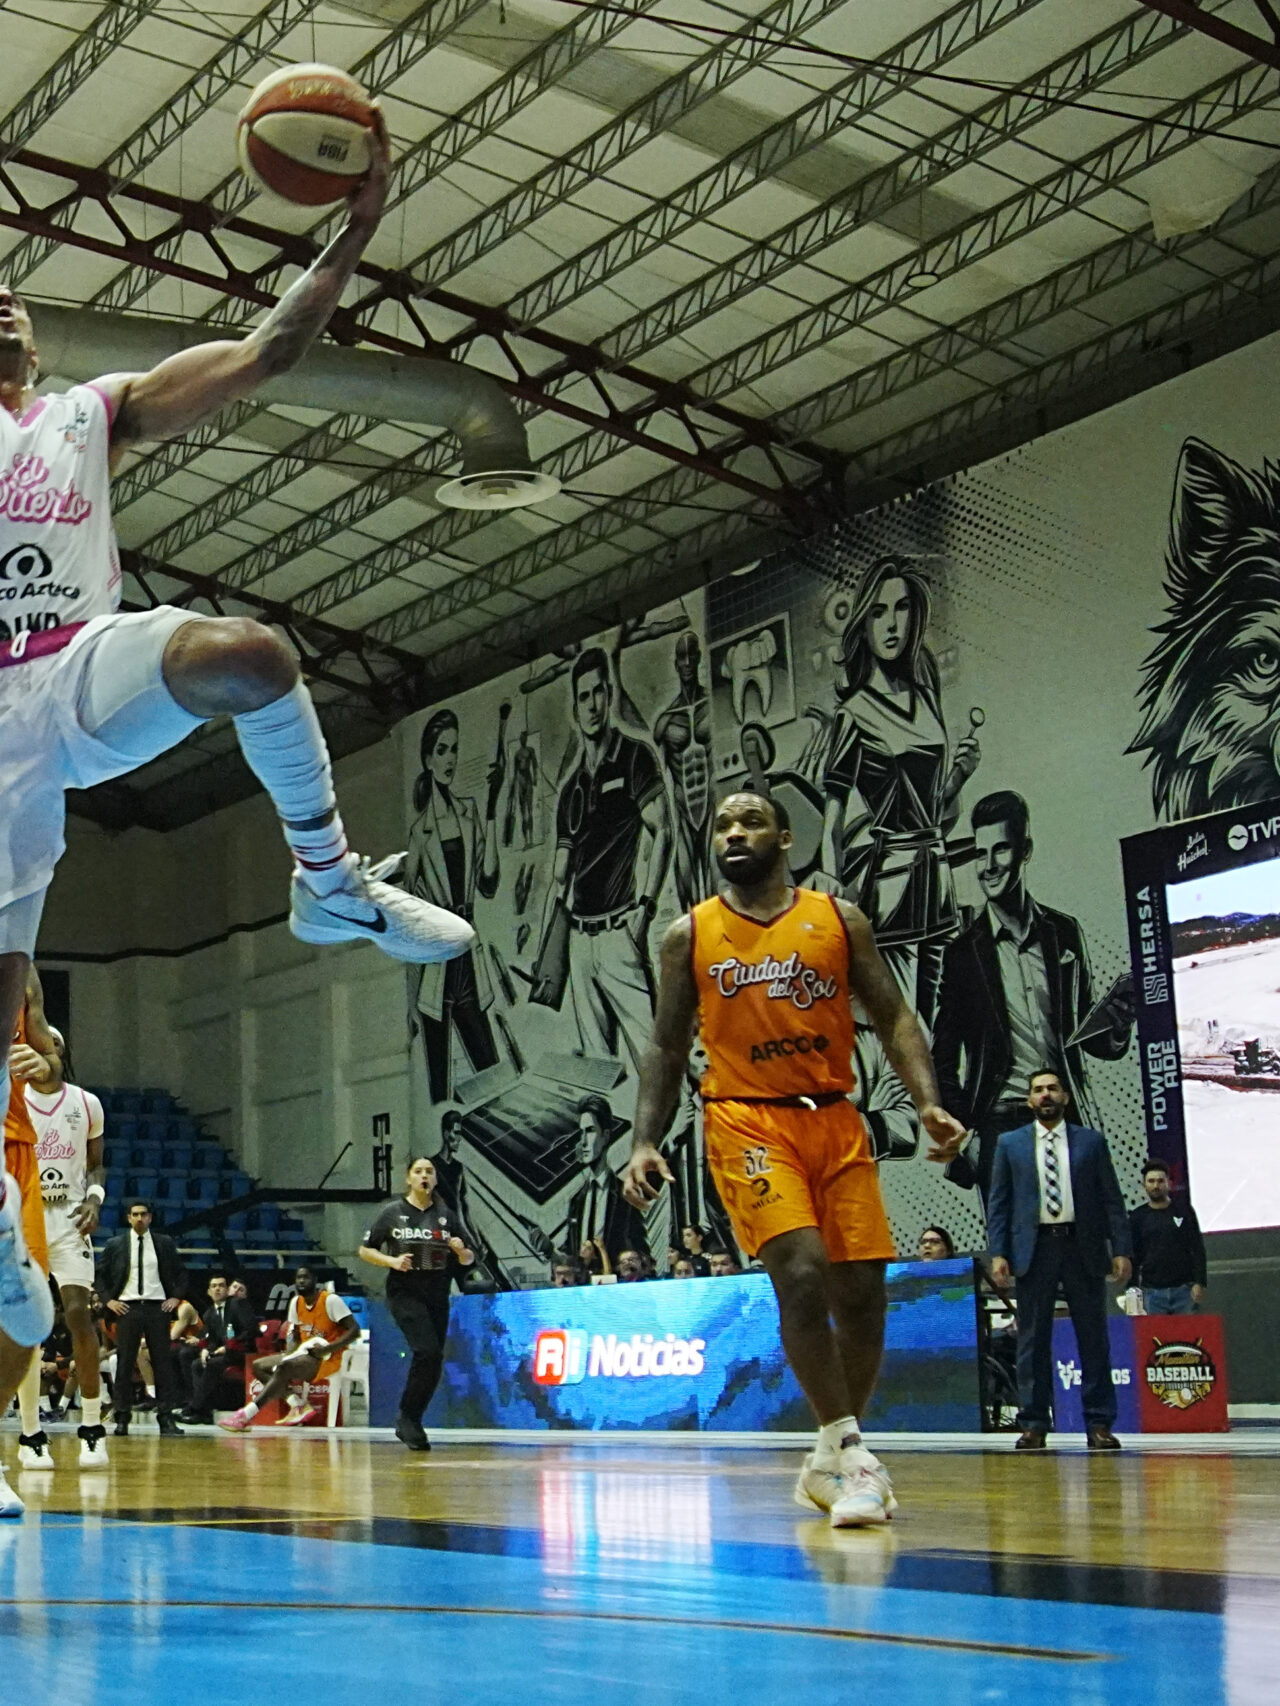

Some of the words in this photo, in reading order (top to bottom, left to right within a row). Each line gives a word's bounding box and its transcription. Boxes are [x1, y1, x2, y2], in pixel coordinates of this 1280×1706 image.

[20, 582, 81, 600] Azteca
[1137, 886, 1158, 973] HERSA
[708, 953, 802, 997] Ciudad
[767, 978, 794, 998] del
[792, 969, 837, 1009] Sol
[1149, 1041, 1168, 1131] POWER
[1162, 1039, 1180, 1089] ADE
[587, 1332, 707, 1377] Noticias
[1146, 1366, 1215, 1383] BASEBALL
